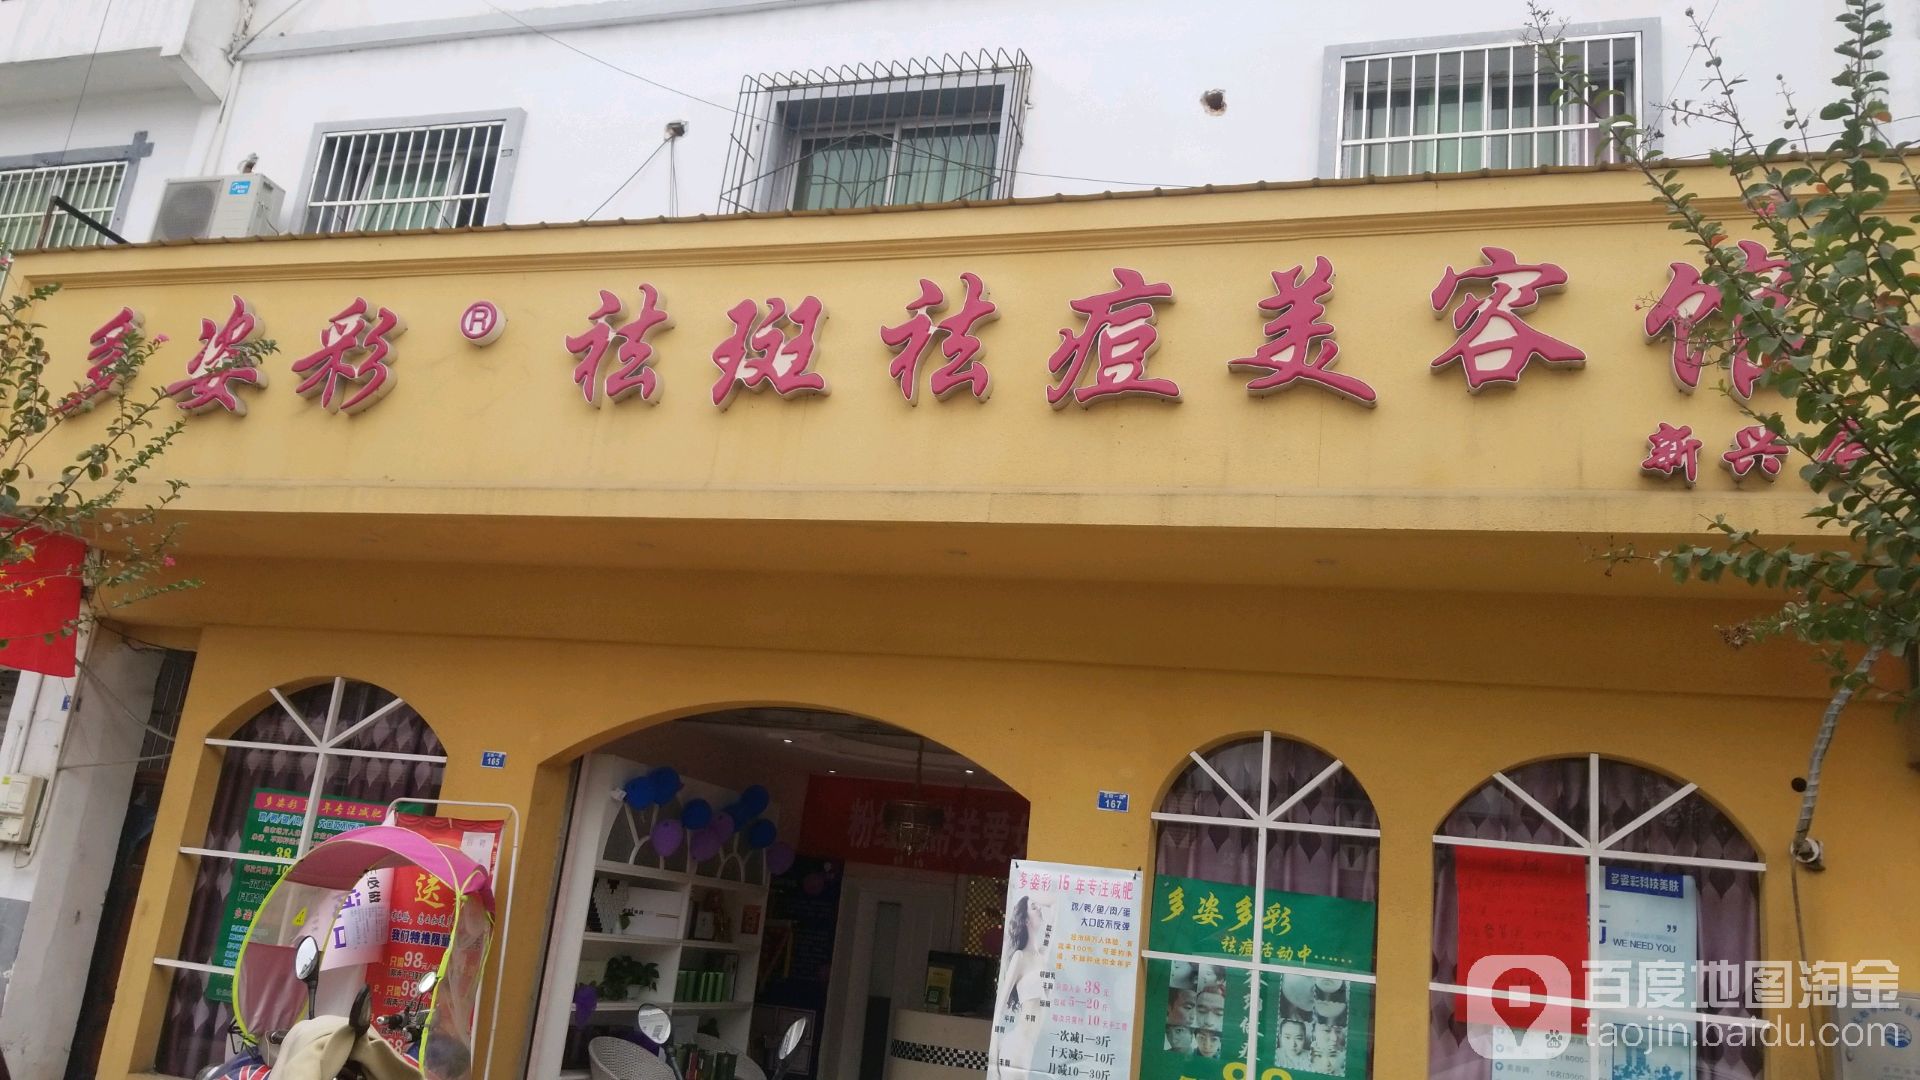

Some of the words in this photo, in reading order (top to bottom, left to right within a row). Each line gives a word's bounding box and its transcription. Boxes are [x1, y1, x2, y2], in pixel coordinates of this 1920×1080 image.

[1105, 799, 1121, 809] 167
[1019, 871, 1052, 892] 多姿彩
[1075, 878, 1133, 900] 年专注减肥
[1161, 886, 1292, 936] 多姿多彩
[1613, 938, 1628, 947] WE
[1630, 940, 1654, 951] NEED
[1655, 943, 1676, 954] YOU
[1084, 980, 1101, 994] 38
[1087, 1015, 1100, 1026] 10
